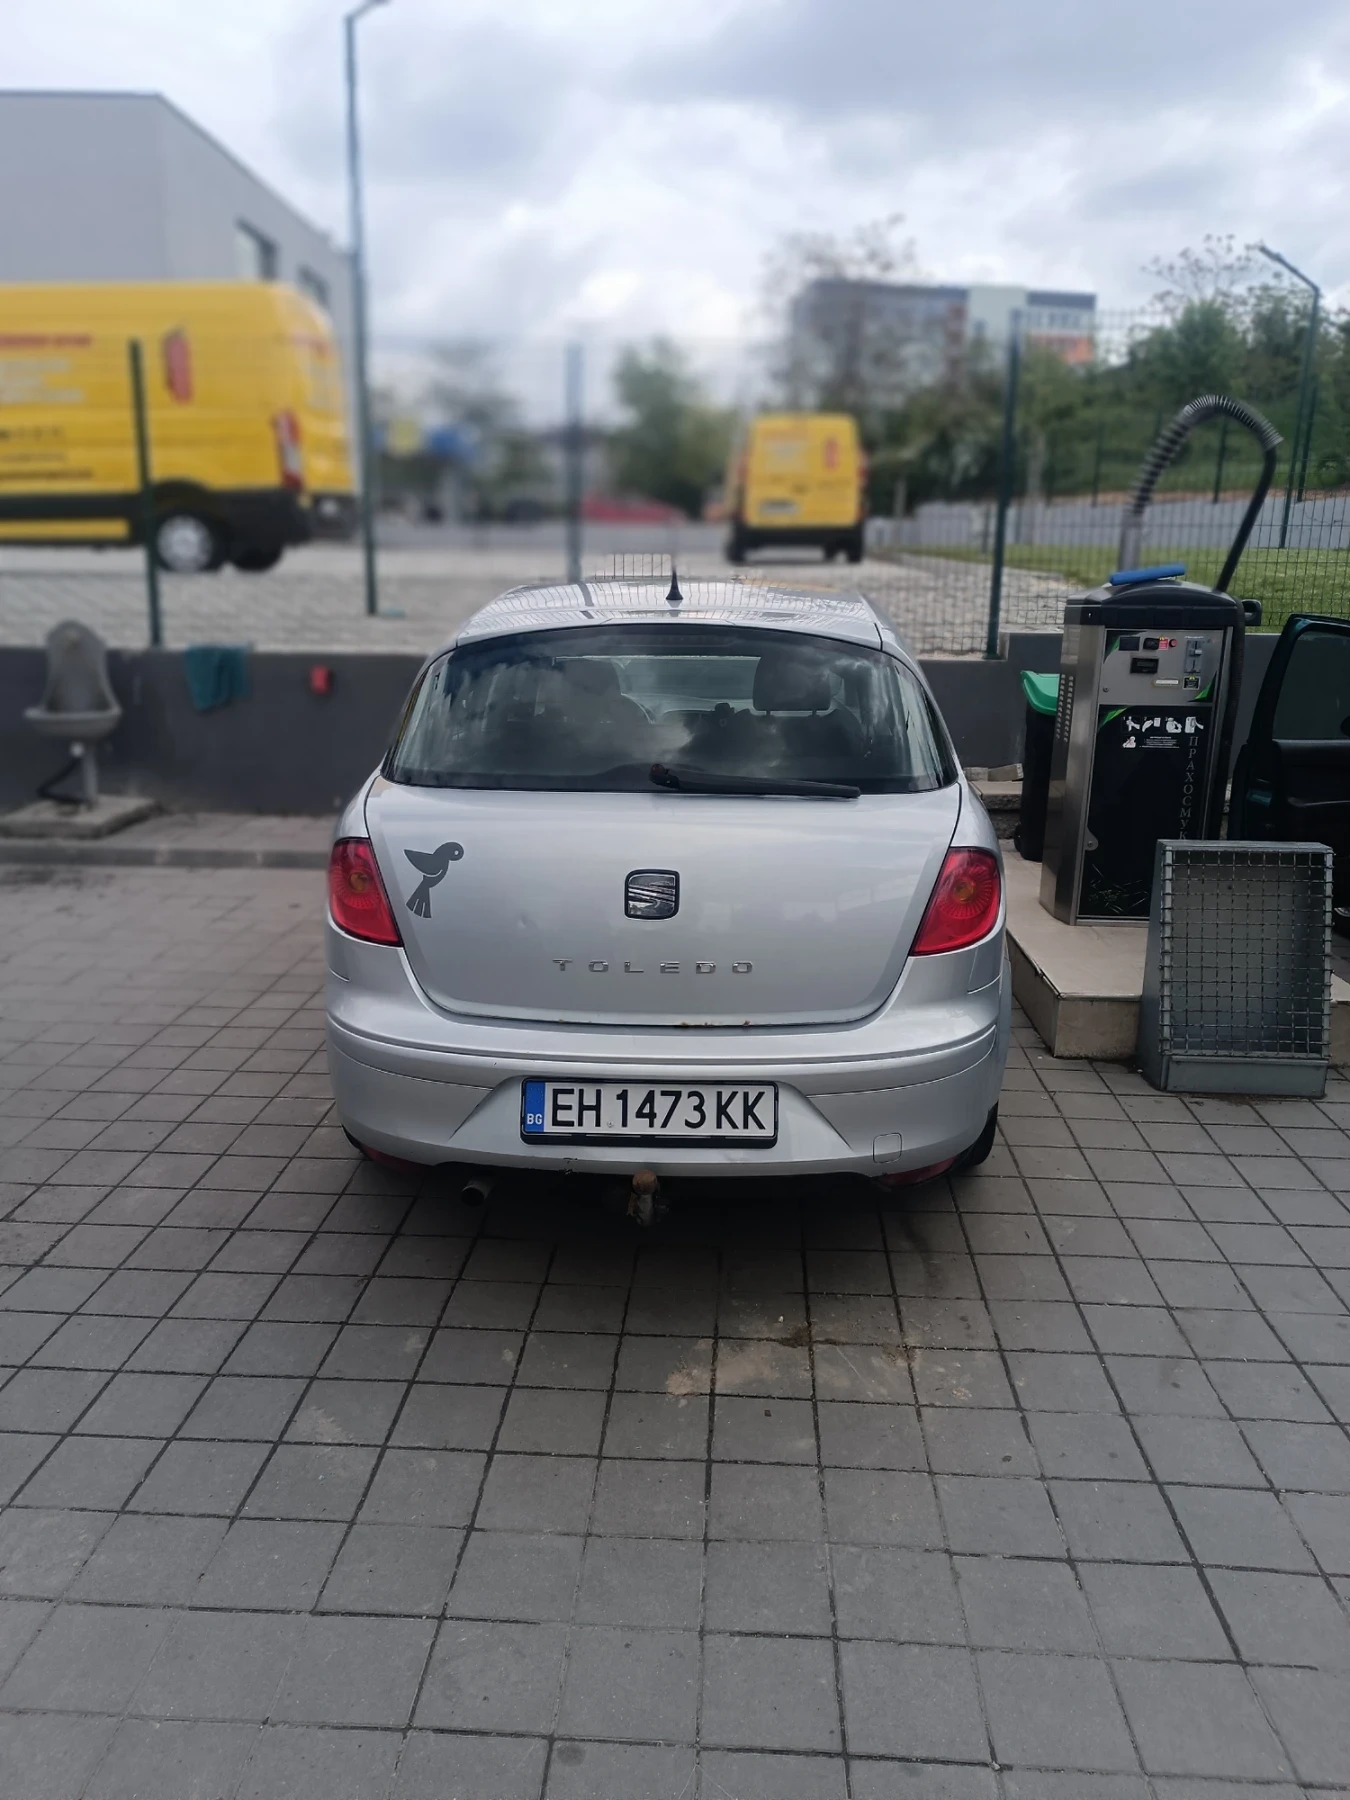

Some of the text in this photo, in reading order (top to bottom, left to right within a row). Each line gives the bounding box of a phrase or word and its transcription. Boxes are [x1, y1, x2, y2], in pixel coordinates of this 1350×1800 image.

[552, 958, 753, 974] TOLEDO
[526, 1088, 766, 1130] BG EH 1473 KK
